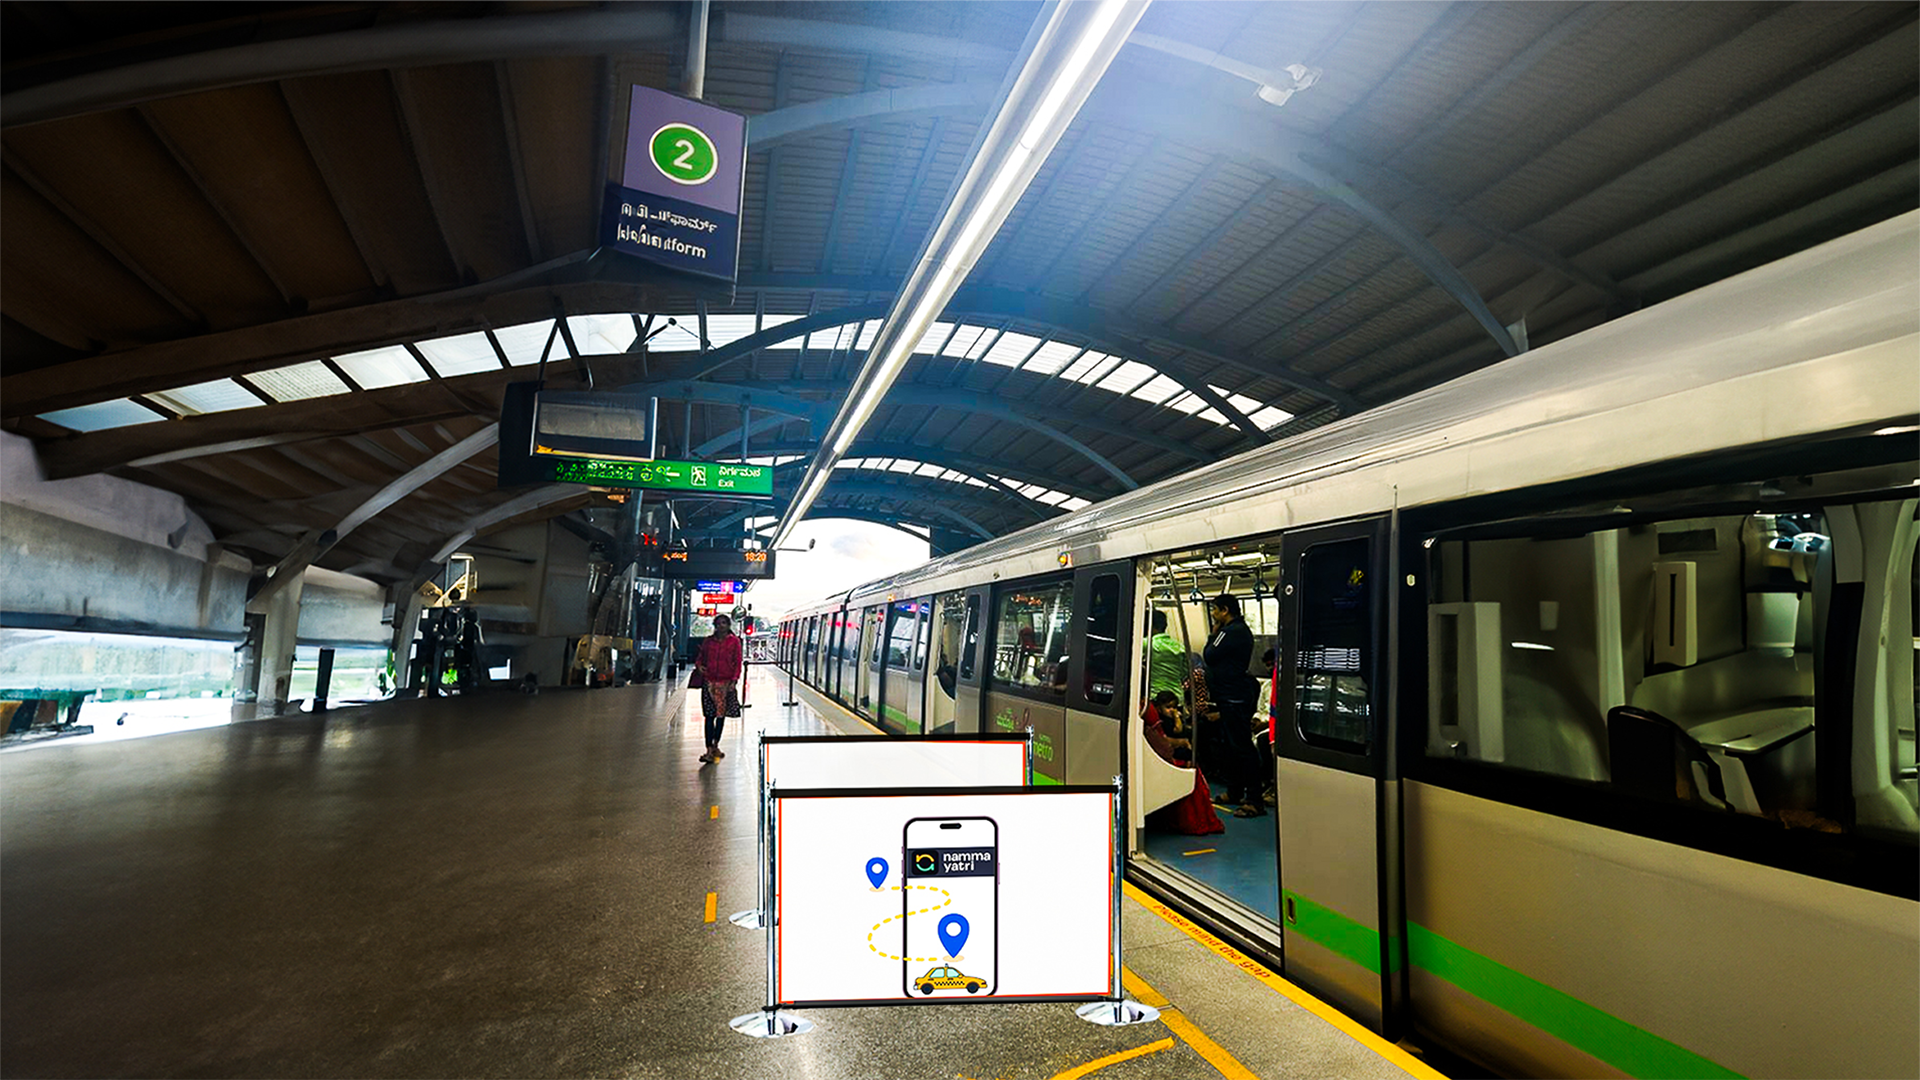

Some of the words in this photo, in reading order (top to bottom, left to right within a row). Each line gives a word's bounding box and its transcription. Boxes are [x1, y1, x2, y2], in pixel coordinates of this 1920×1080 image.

[673, 139, 695, 170] 2
[718, 479, 734, 487] Exit
[943, 852, 991, 862] namma
[943, 861, 975, 873] yatri
[1239, 960, 1270, 978] gap
